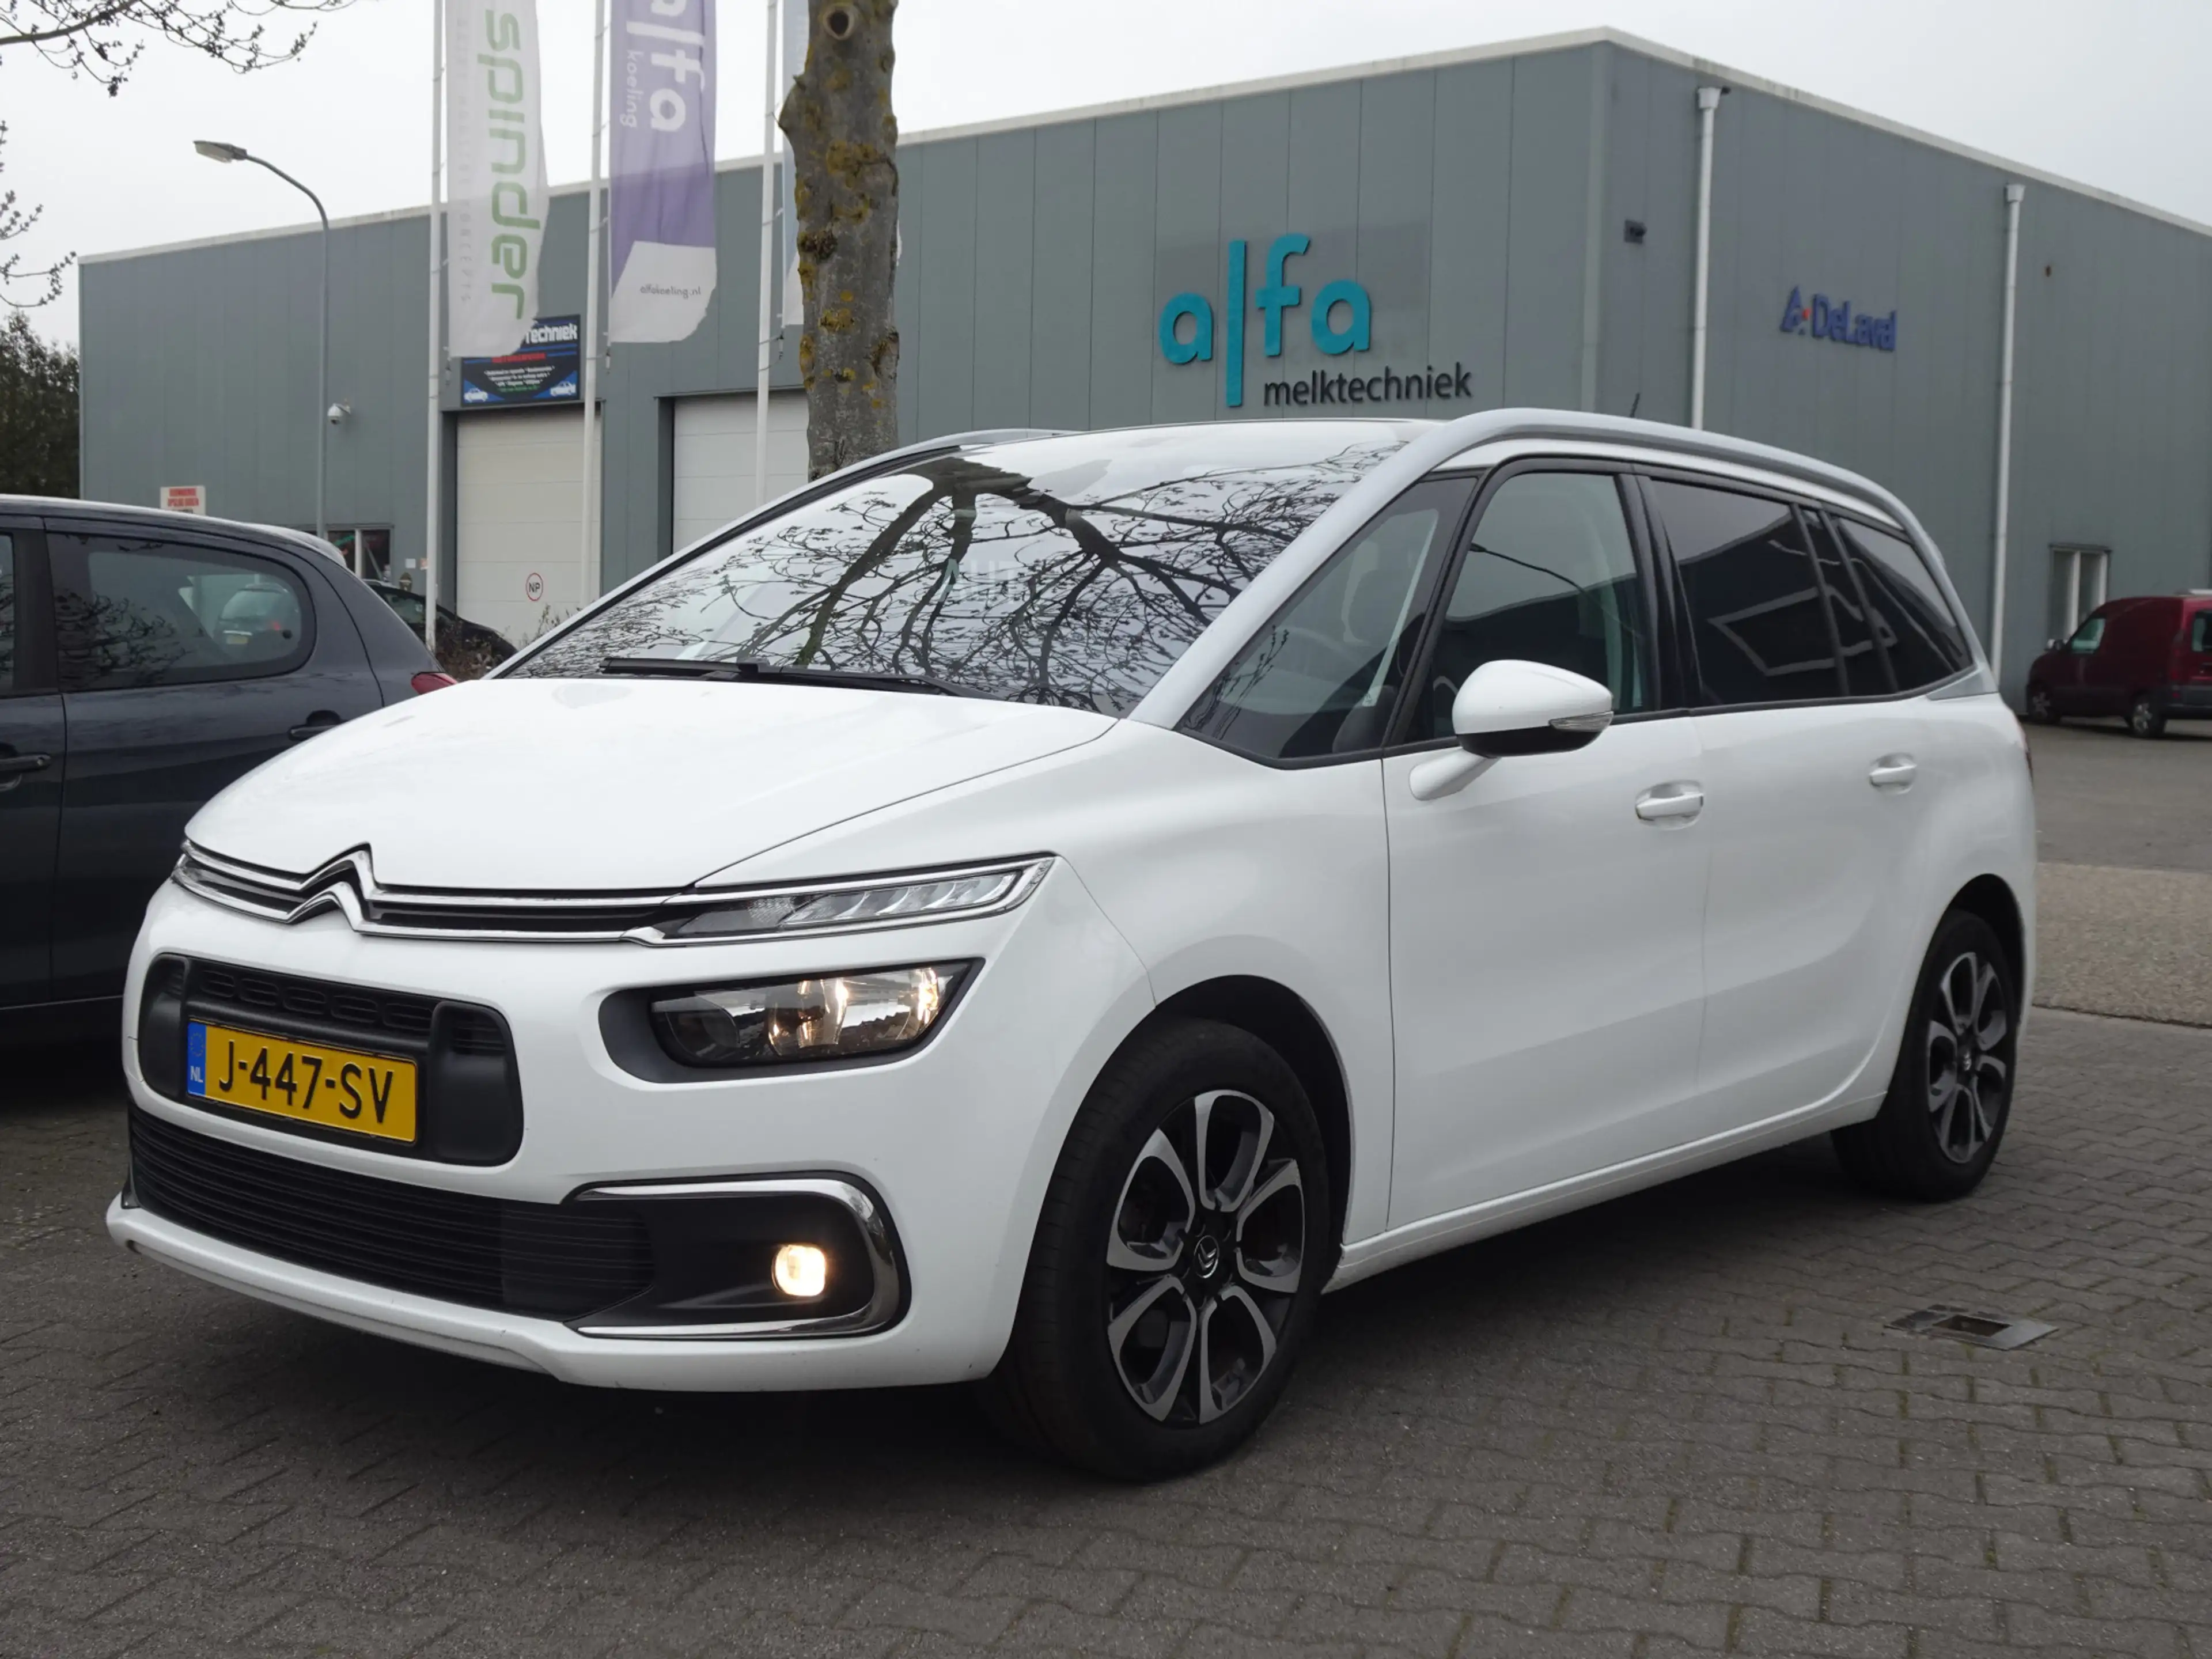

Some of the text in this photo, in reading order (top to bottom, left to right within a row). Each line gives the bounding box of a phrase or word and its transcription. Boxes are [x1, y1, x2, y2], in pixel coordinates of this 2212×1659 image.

[620, 50, 646, 128] koeling
[477, 9, 540, 319] spinder
[1158, 233, 1372, 408] alfa
[1811, 293, 1897, 353] DeLaval
[1264, 362, 1472, 407] melktechniek
[190, 1065, 203, 1083] NL
[218, 1039, 395, 1123] J-447-SV
